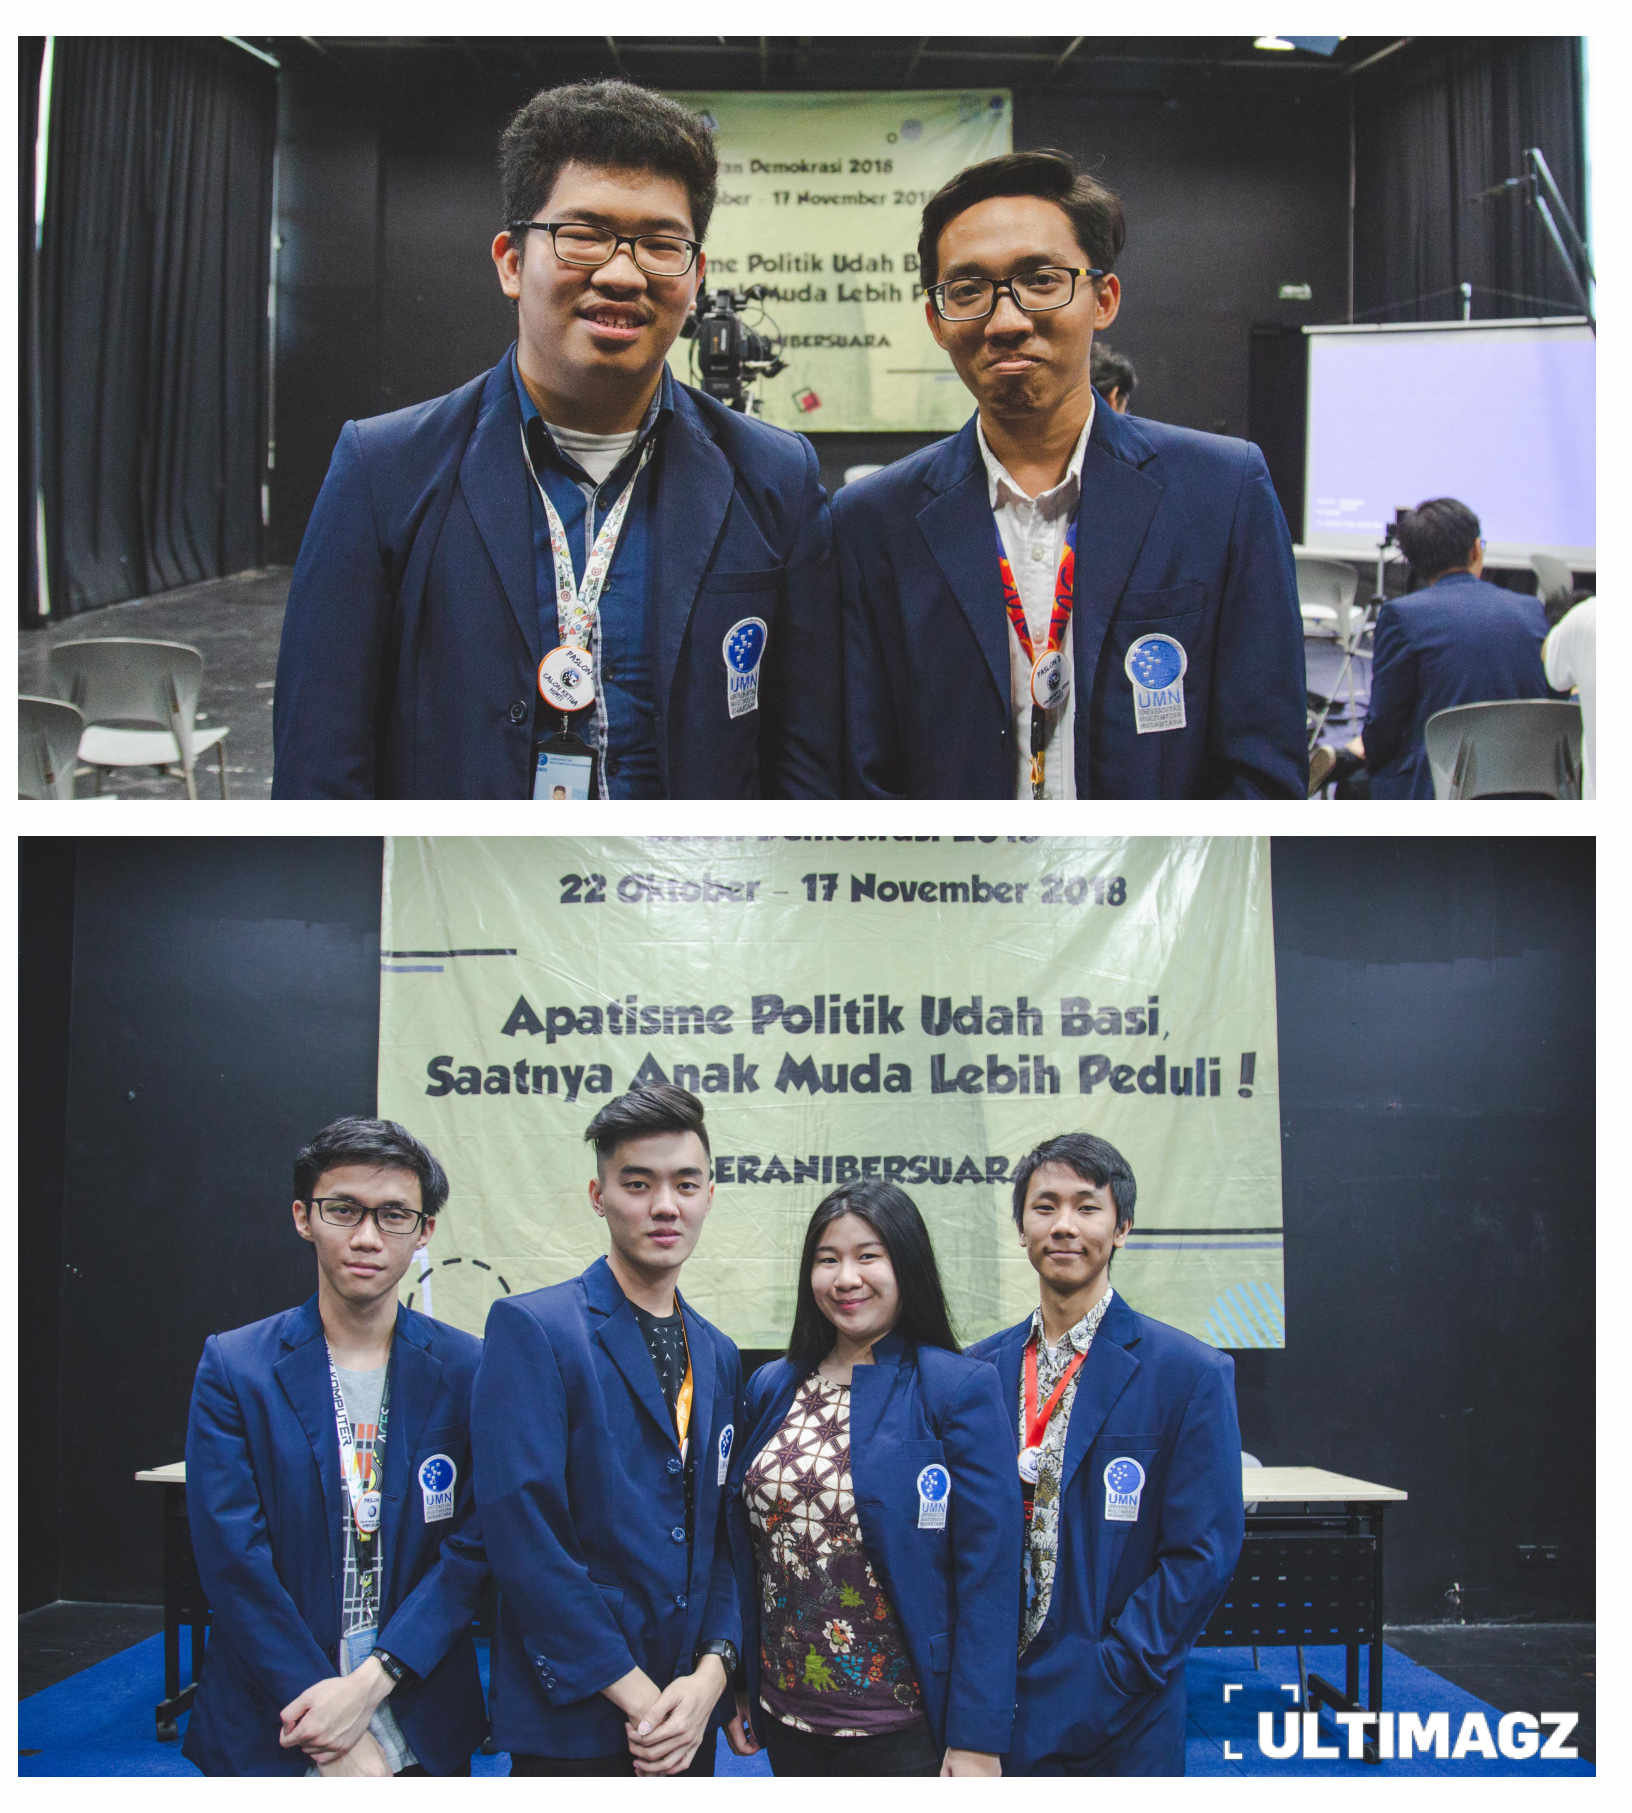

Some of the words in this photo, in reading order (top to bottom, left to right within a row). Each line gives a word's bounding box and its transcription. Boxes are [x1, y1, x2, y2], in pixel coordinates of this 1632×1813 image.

[750, 158, 842, 174] Demokrasi
[849, 157, 894, 174] 2018
[773, 190, 791, 206] 17
[797, 189, 886, 206] November
[748, 253, 823, 274] Politik
[833, 252, 894, 274] Udah
[838, 282, 902, 303] Lebih
[566, 650, 593, 676] PASLON
[543, 672, 563, 691] CALON
[560, 689, 579, 707] KETUA
[731, 672, 759, 693] UMN
[1138, 689, 1181, 708] UMN
[559, 873, 606, 903] 22
[616, 873, 761, 904] Oktober
[801, 873, 839, 902] 17
[851, 873, 1029, 903] November
[1040, 875, 1128, 907] 2018
[501, 994, 734, 1044] Apatisme
[751, 994, 905, 1036] Politik
[921, 995, 1043, 1037] Udah
[1060, 995, 1170, 1041] Basi,
[425, 1055, 613, 1102] Saatnya
[627, 1052, 760, 1094] Anak
[774, 1052, 912, 1095] Muda
[930, 1053, 1061, 1095] Lebih
[1079, 1053, 1222, 1098] Peduli
[709, 1154, 1017, 1186] ERANIBERSUAR
[426, 1492, 452, 1506] UMN
[922, 1502, 946, 1513] UMN
[1108, 1493, 1138, 1506] UMN
